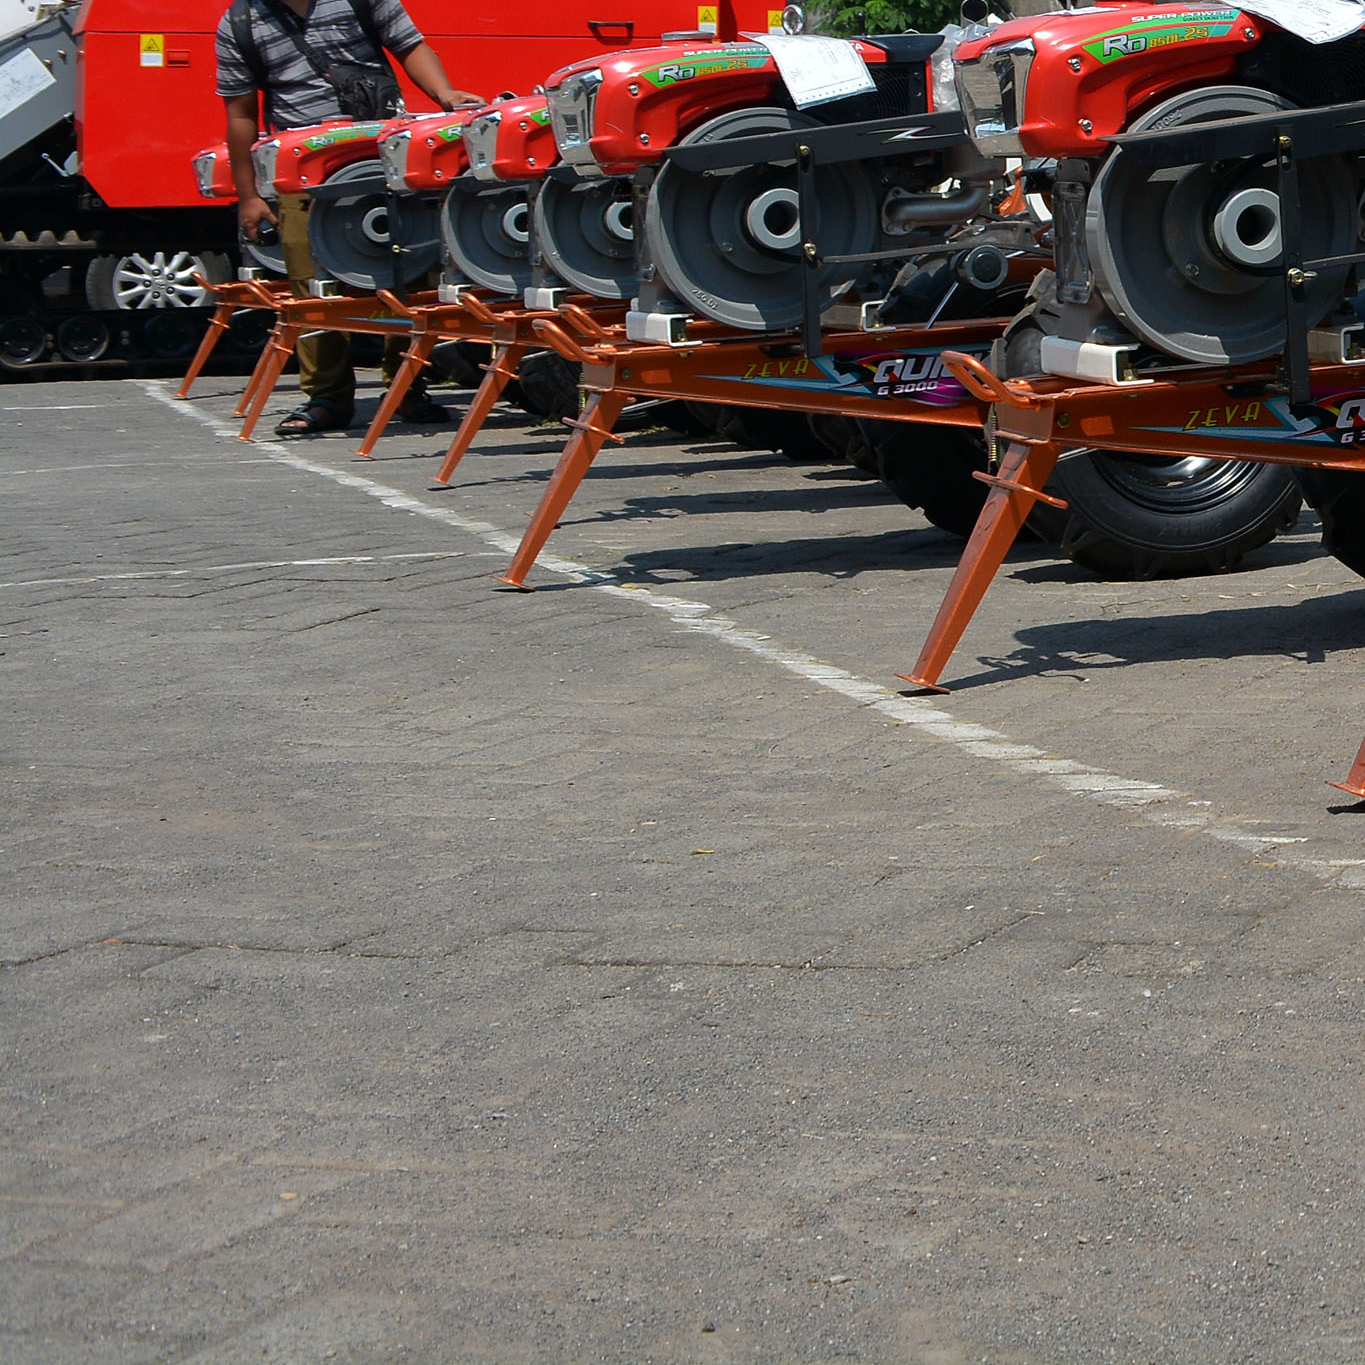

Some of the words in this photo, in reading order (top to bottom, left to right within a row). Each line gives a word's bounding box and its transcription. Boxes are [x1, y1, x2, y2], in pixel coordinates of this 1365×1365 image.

[1131, 13, 1178, 23] SUPER
[743, 358, 811, 380] ZEVA
[873, 351, 992, 384] QUI
[877, 385, 890, 396] G
[893, 380, 940, 394] 3000
[1183, 400, 1262, 431] ZEVA
[1340, 432, 1354, 444] G
